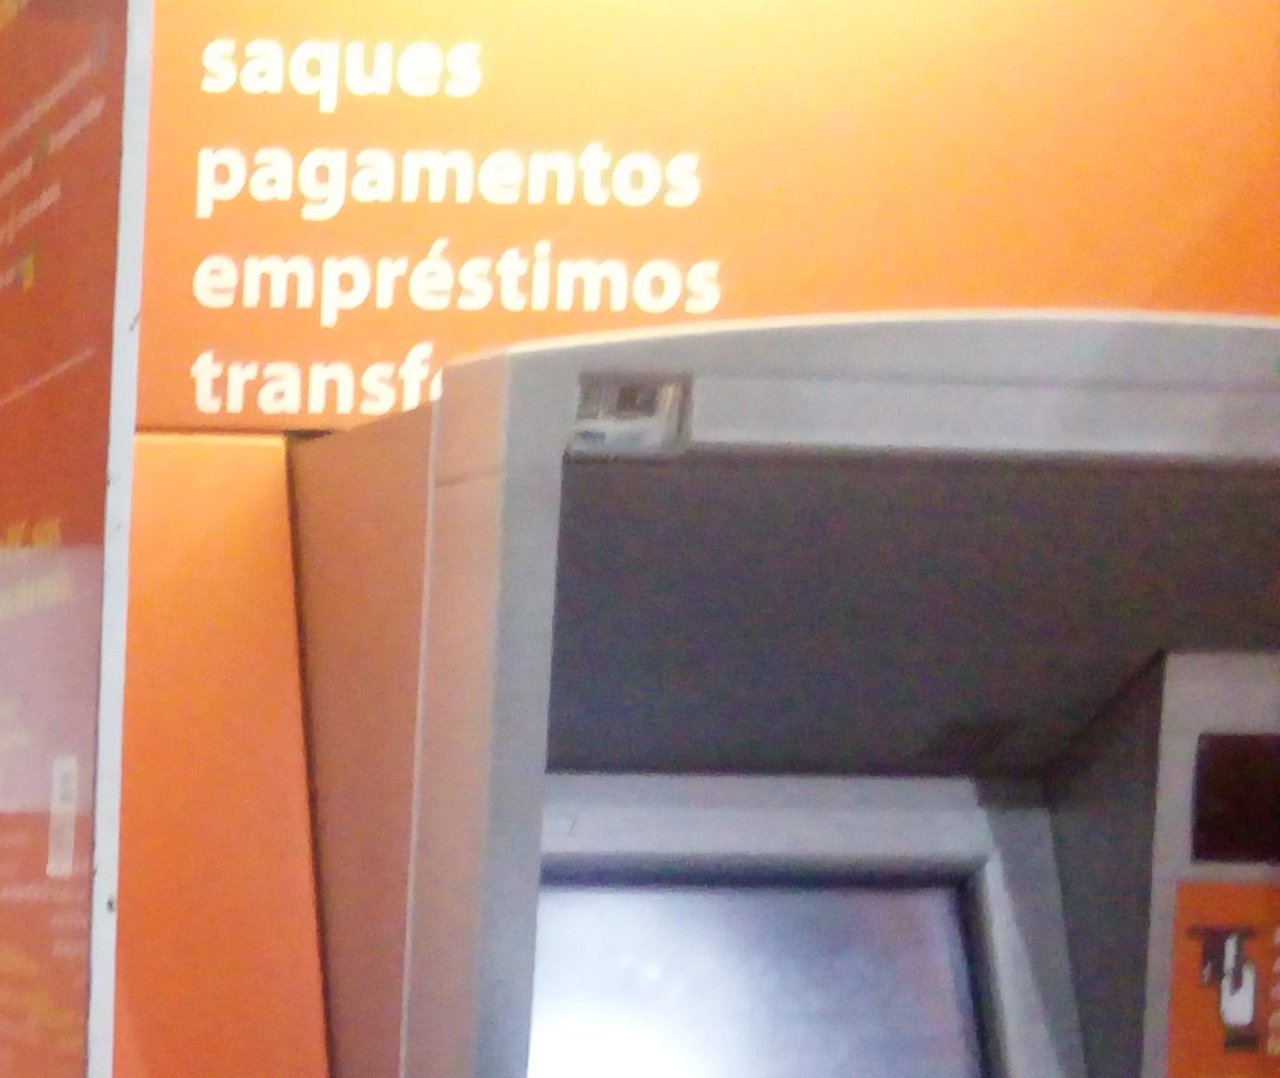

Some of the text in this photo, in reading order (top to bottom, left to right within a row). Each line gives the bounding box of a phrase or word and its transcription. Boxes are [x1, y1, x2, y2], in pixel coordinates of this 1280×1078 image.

[199, 36, 484, 114] saques
[195, 141, 703, 221] pagamentos
[192, 238, 721, 328] empréstimos
[190, 342, 442, 416] transf
